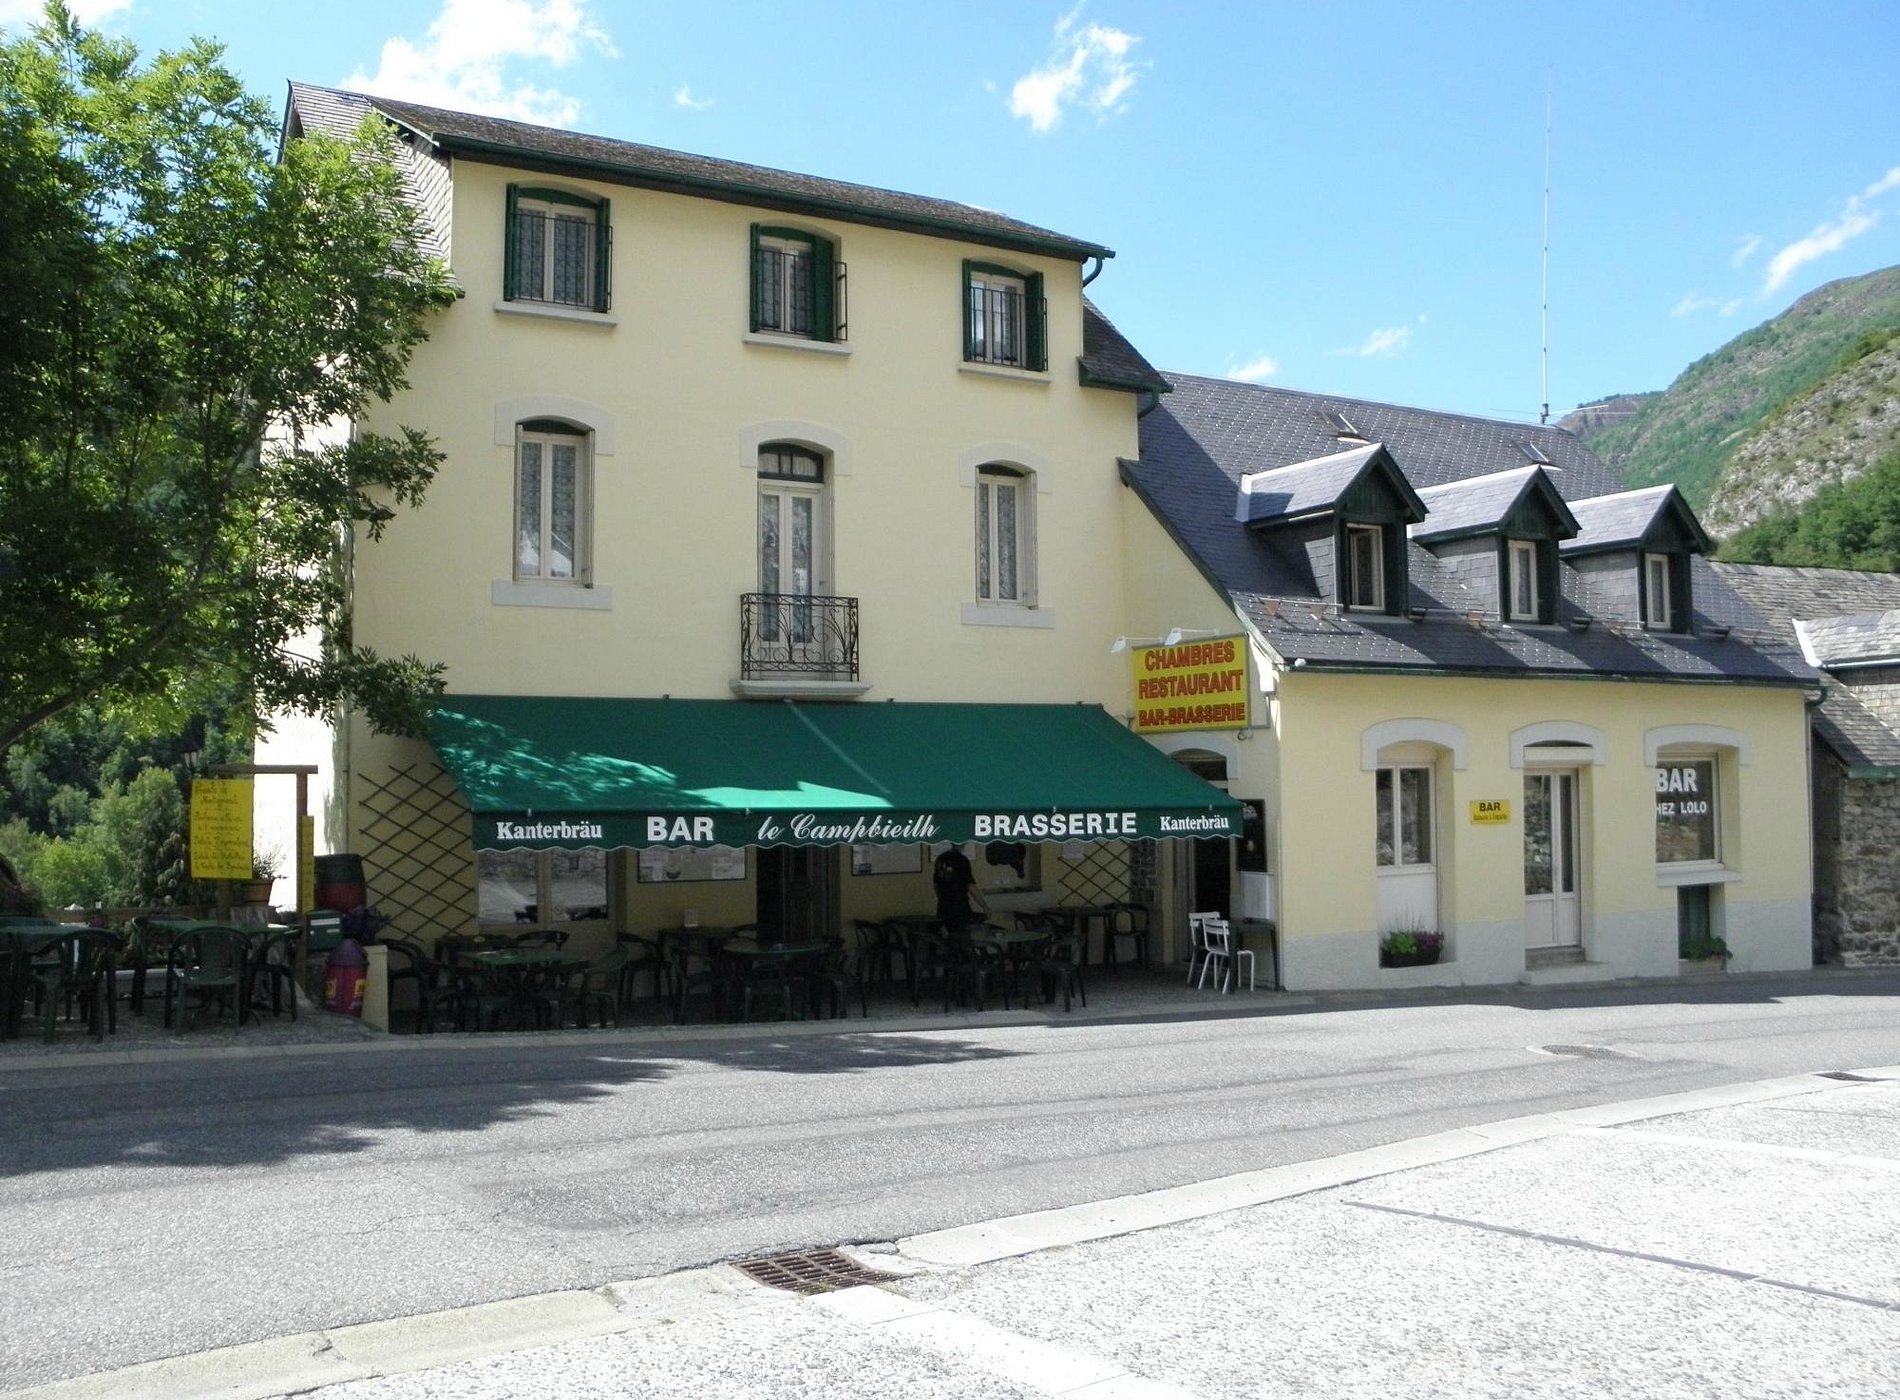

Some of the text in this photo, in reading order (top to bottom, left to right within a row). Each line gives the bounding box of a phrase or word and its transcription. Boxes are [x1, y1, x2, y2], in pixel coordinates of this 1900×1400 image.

[1144, 640, 1236, 672] CHAMBRES
[1138, 669, 1244, 700] RESTAURANT
[1138, 702, 1246, 728] BAR-BRASSERIE
[1656, 767, 1698, 793] BAR
[1479, 801, 1501, 812] BAR
[1680, 801, 1707, 814] LOLO
[496, 820, 603, 840] Kanterbräu
[646, 816, 714, 842] BAR
[790, 813, 941, 844] Campbieilh
[975, 812, 1138, 837] BRASSERIE
[1160, 814, 1230, 831] Kanterbräu
